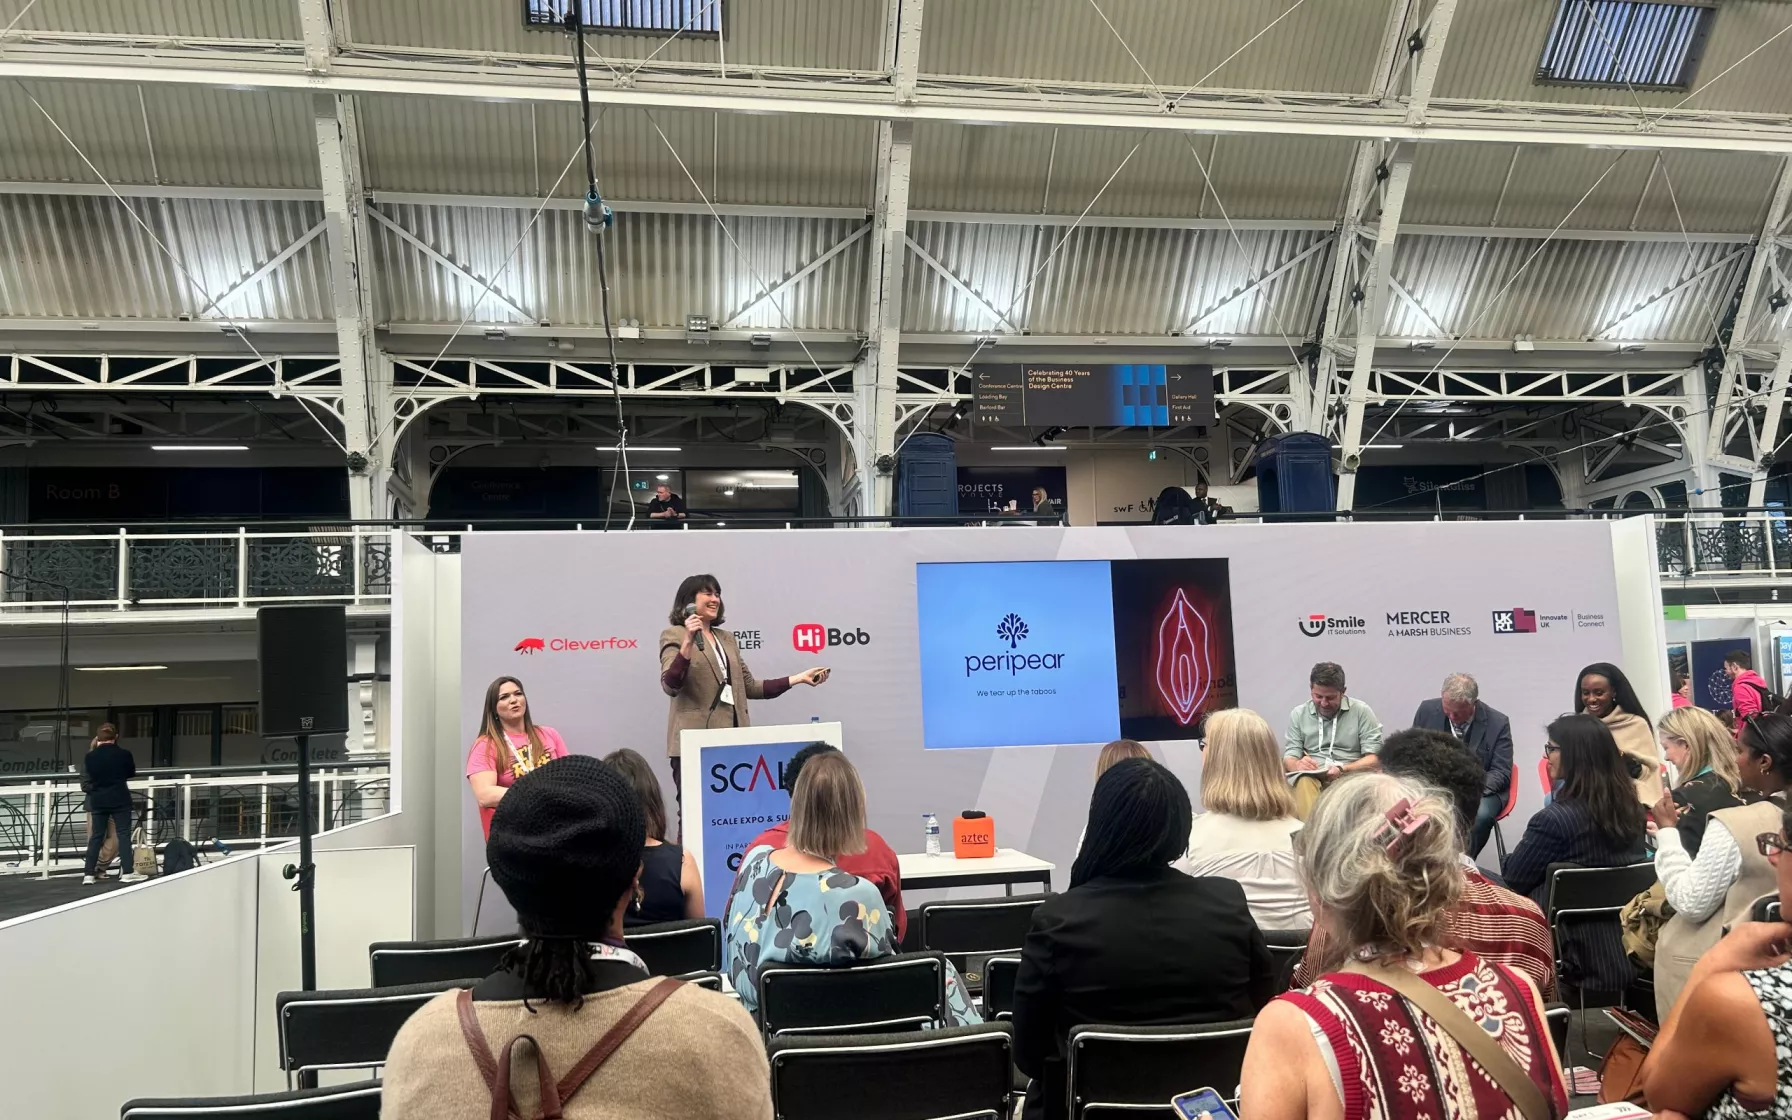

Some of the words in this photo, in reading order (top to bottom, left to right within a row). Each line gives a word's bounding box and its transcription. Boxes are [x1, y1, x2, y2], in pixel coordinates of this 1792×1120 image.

[1027, 369, 1064, 377] Celebrating
[46, 484, 101, 500] Room
[108, 483, 121, 499] B
[957, 484, 1003, 492] ROJECTS
[1327, 615, 1366, 628] Smile
[1386, 610, 1451, 625] MERCER
[1494, 612, 1513, 623] UK
[733, 630, 761, 640] RATE
[827, 627, 871, 647] Bob
[1396, 628, 1428, 637] MARSH
[1430, 627, 1472, 636] BUSINESS
[550, 636, 638, 651] Cleverfox
[738, 640, 761, 650] LER
[964, 650, 1065, 677] peripear
[1006, 690, 1017, 699] up
[1017, 688, 1030, 696] the
[271, 748, 339, 762] Comlete
[710, 753, 787, 793] SCAL
[711, 817, 738, 826] SCALE
[740, 815, 765, 825] EXPO
[776, 814, 791, 822] SU
[961, 833, 989, 843] aztec
